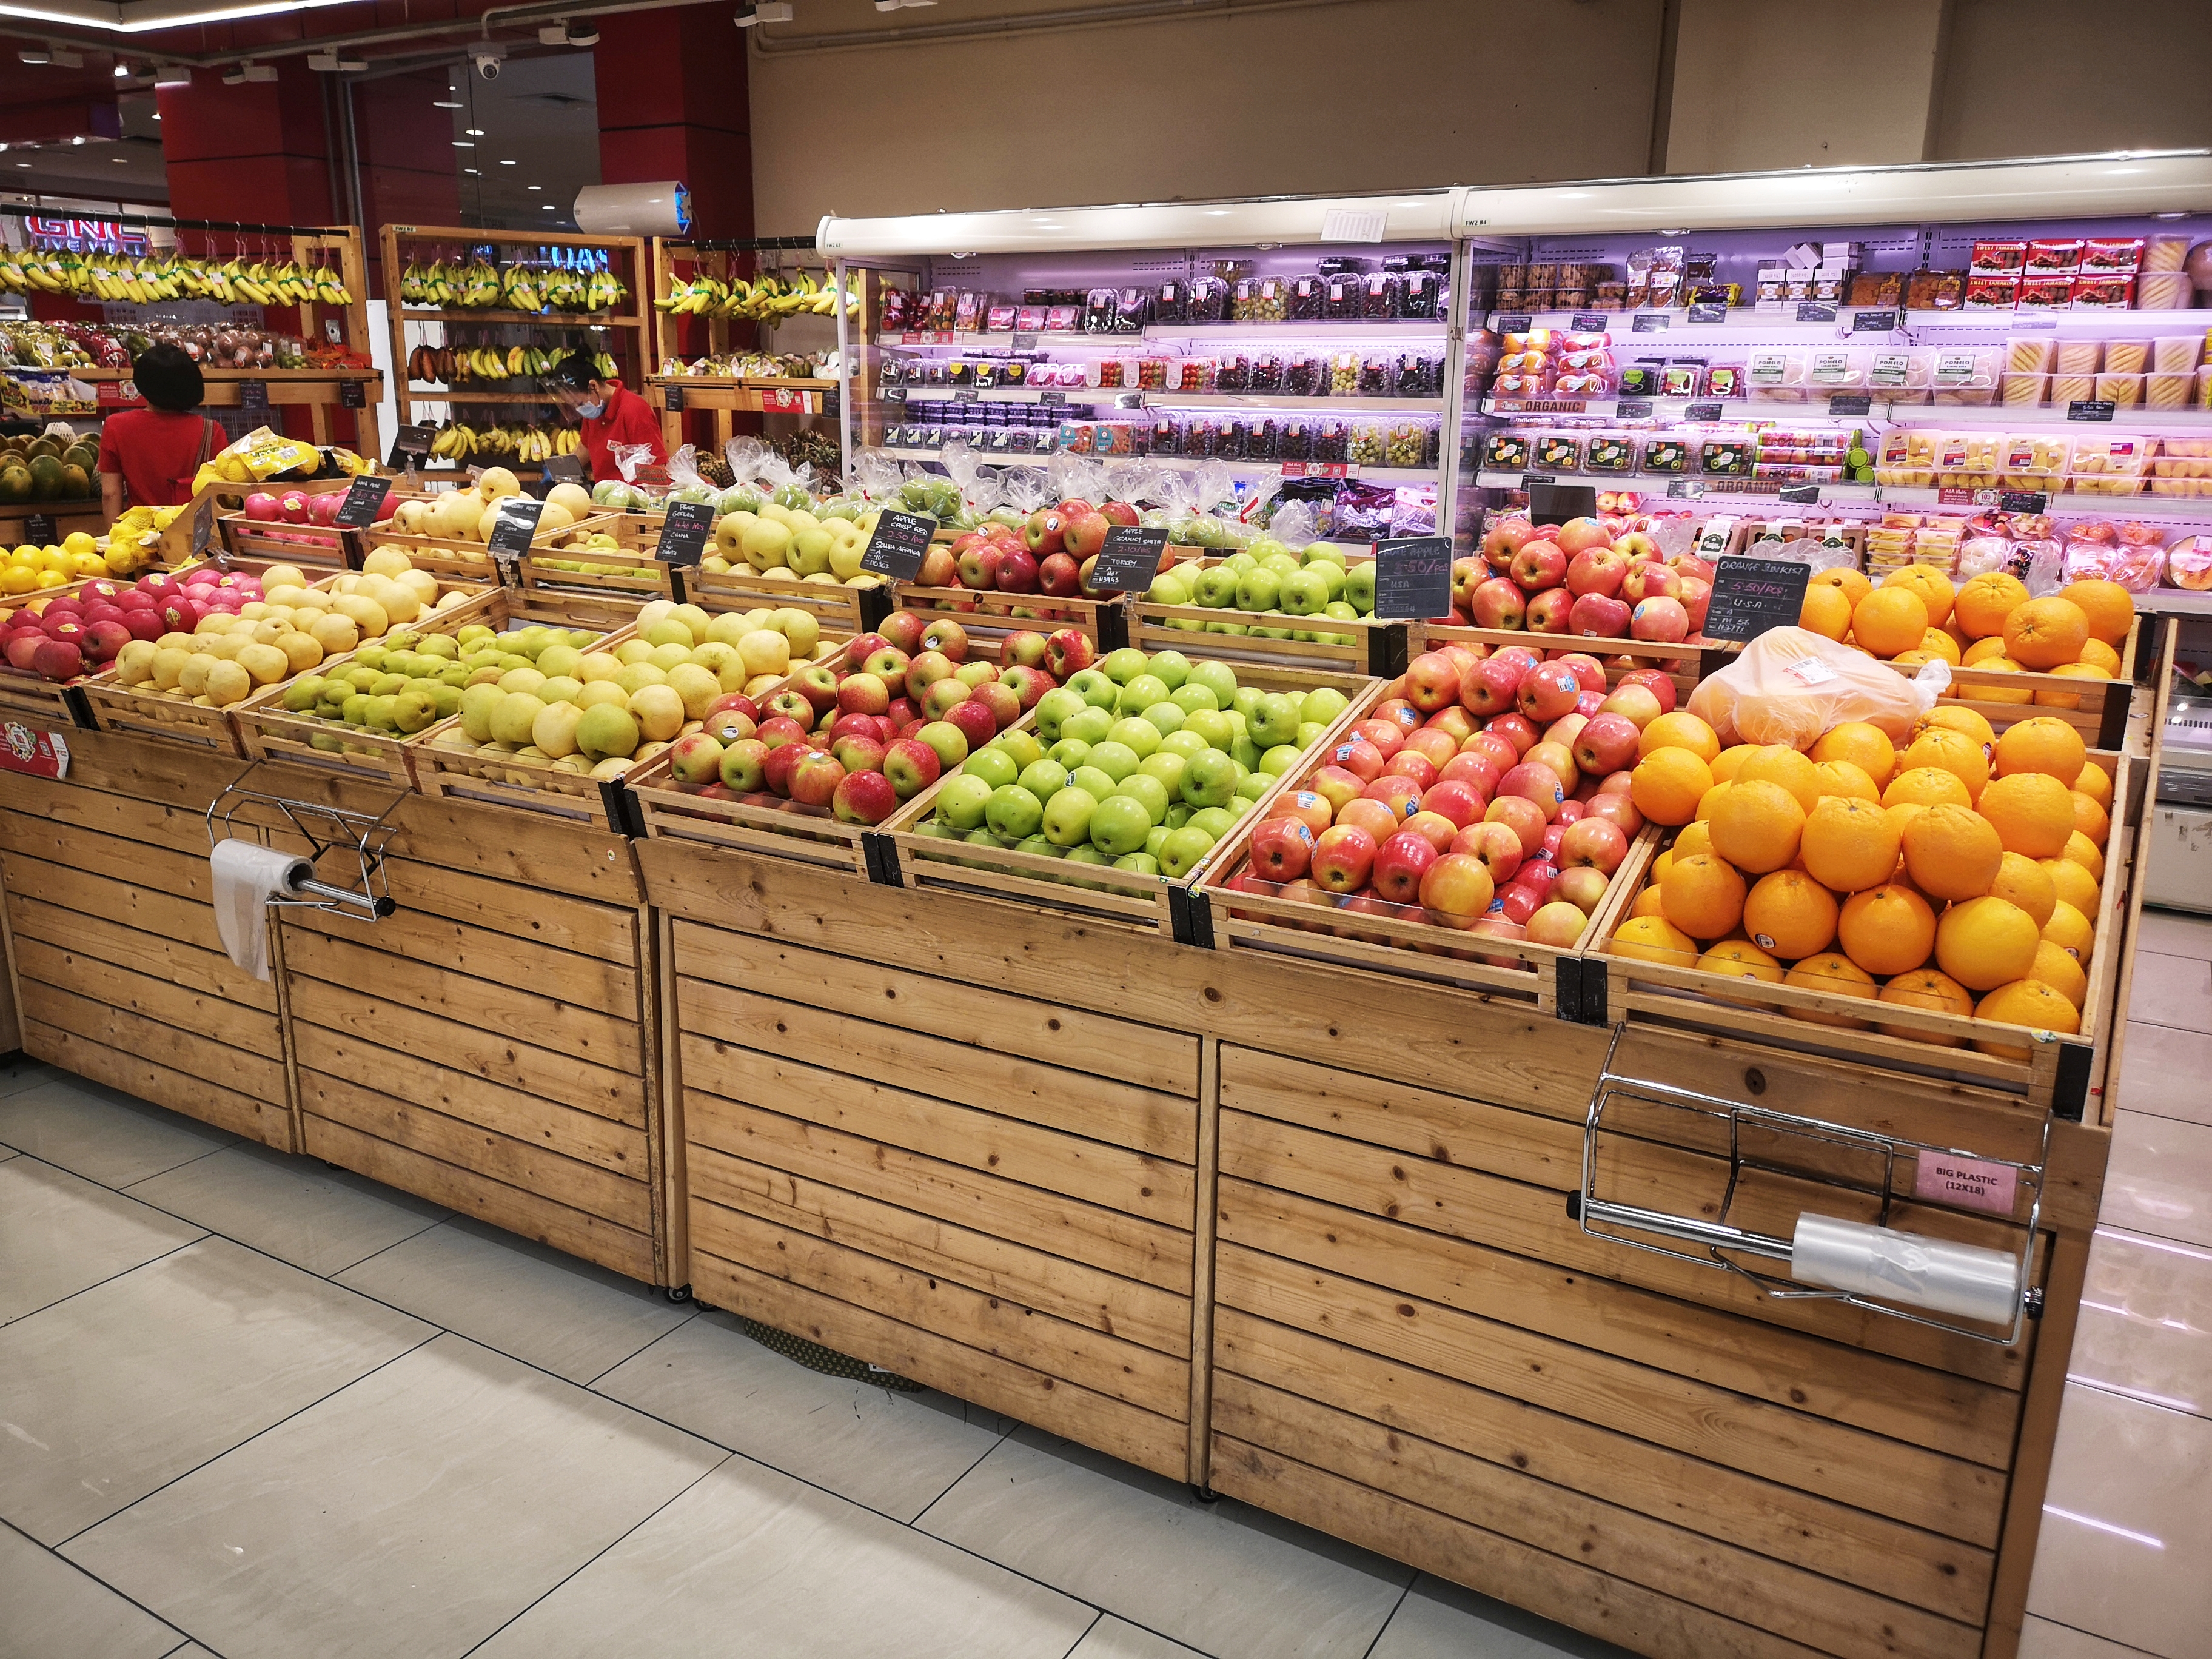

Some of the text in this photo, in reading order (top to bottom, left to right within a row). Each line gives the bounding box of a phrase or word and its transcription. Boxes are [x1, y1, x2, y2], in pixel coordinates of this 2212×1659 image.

[1525, 401, 1581, 412] ORGANIC
[1717, 481, 1777, 493] ORGANIC
[893, 514, 917, 525] APPLE
[891, 522, 928, 536] CRISP RED
[887, 531, 908, 540] 2.50
[876, 541, 920, 557] SOUTH AFRICA
[1410, 546, 1440, 557] APPLE
[1111, 558, 1138, 567] TURKEY
[1720, 561, 1804, 575] ORANGE SUNKIST
[1936, 1167, 1998, 1185] BIG PLASTIC
[1946, 1181, 1985, 1196] (12X18)
